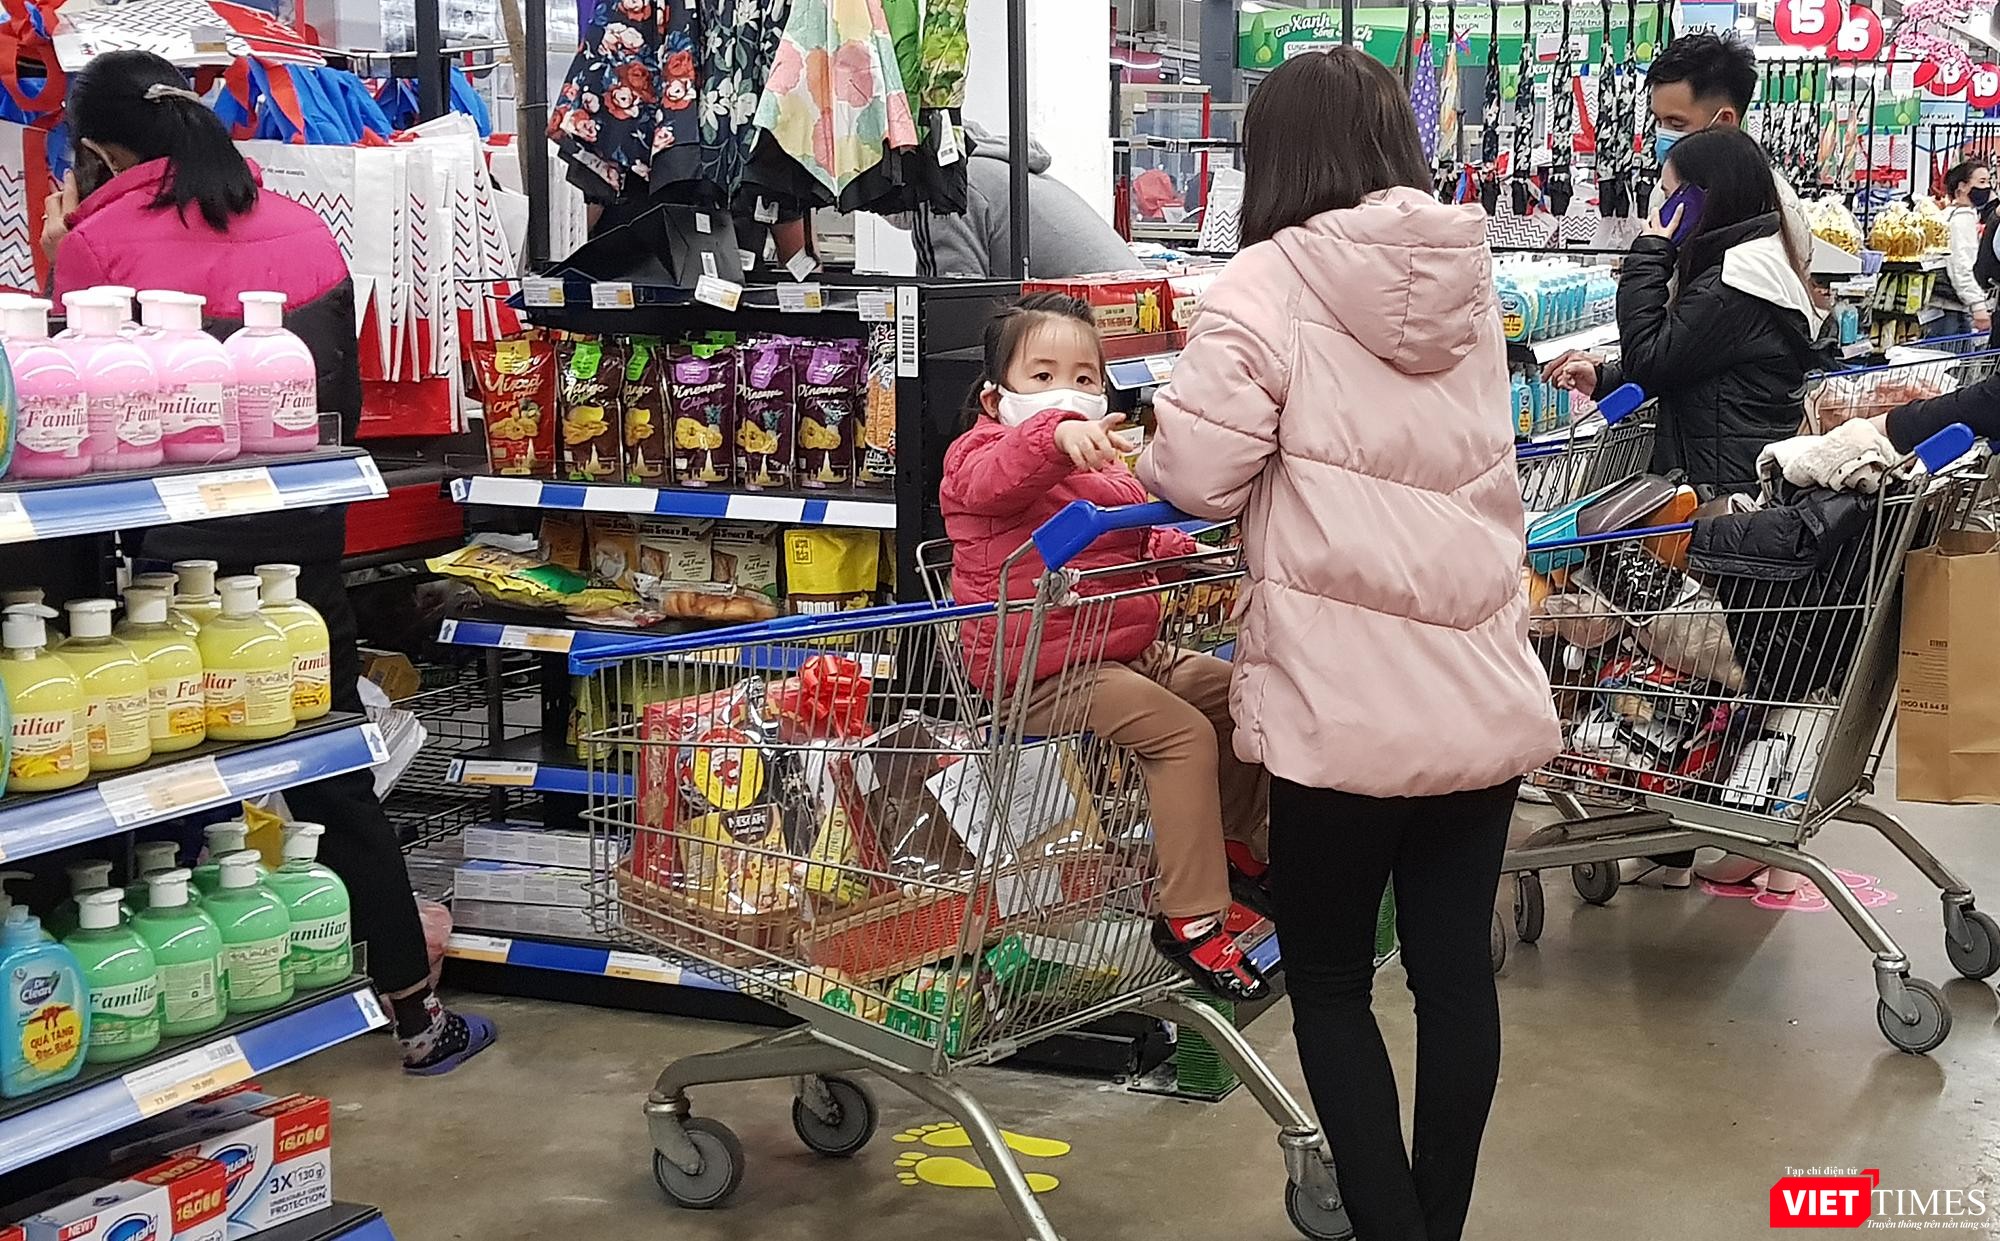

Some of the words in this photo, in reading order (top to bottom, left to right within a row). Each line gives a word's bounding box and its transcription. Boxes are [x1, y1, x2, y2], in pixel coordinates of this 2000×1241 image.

[1291, 13, 1330, 31] Xanh
[1786, 0, 1825, 34] 15
[1335, 22, 1373, 41] Sch
[1972, 71, 1999, 97] 19
[485, 372, 544, 395] Mixed
[22, 986, 52, 1001] Clean
[270, 1172, 293, 1194] 3X
[270, 1191, 327, 1217] PROTECTION
